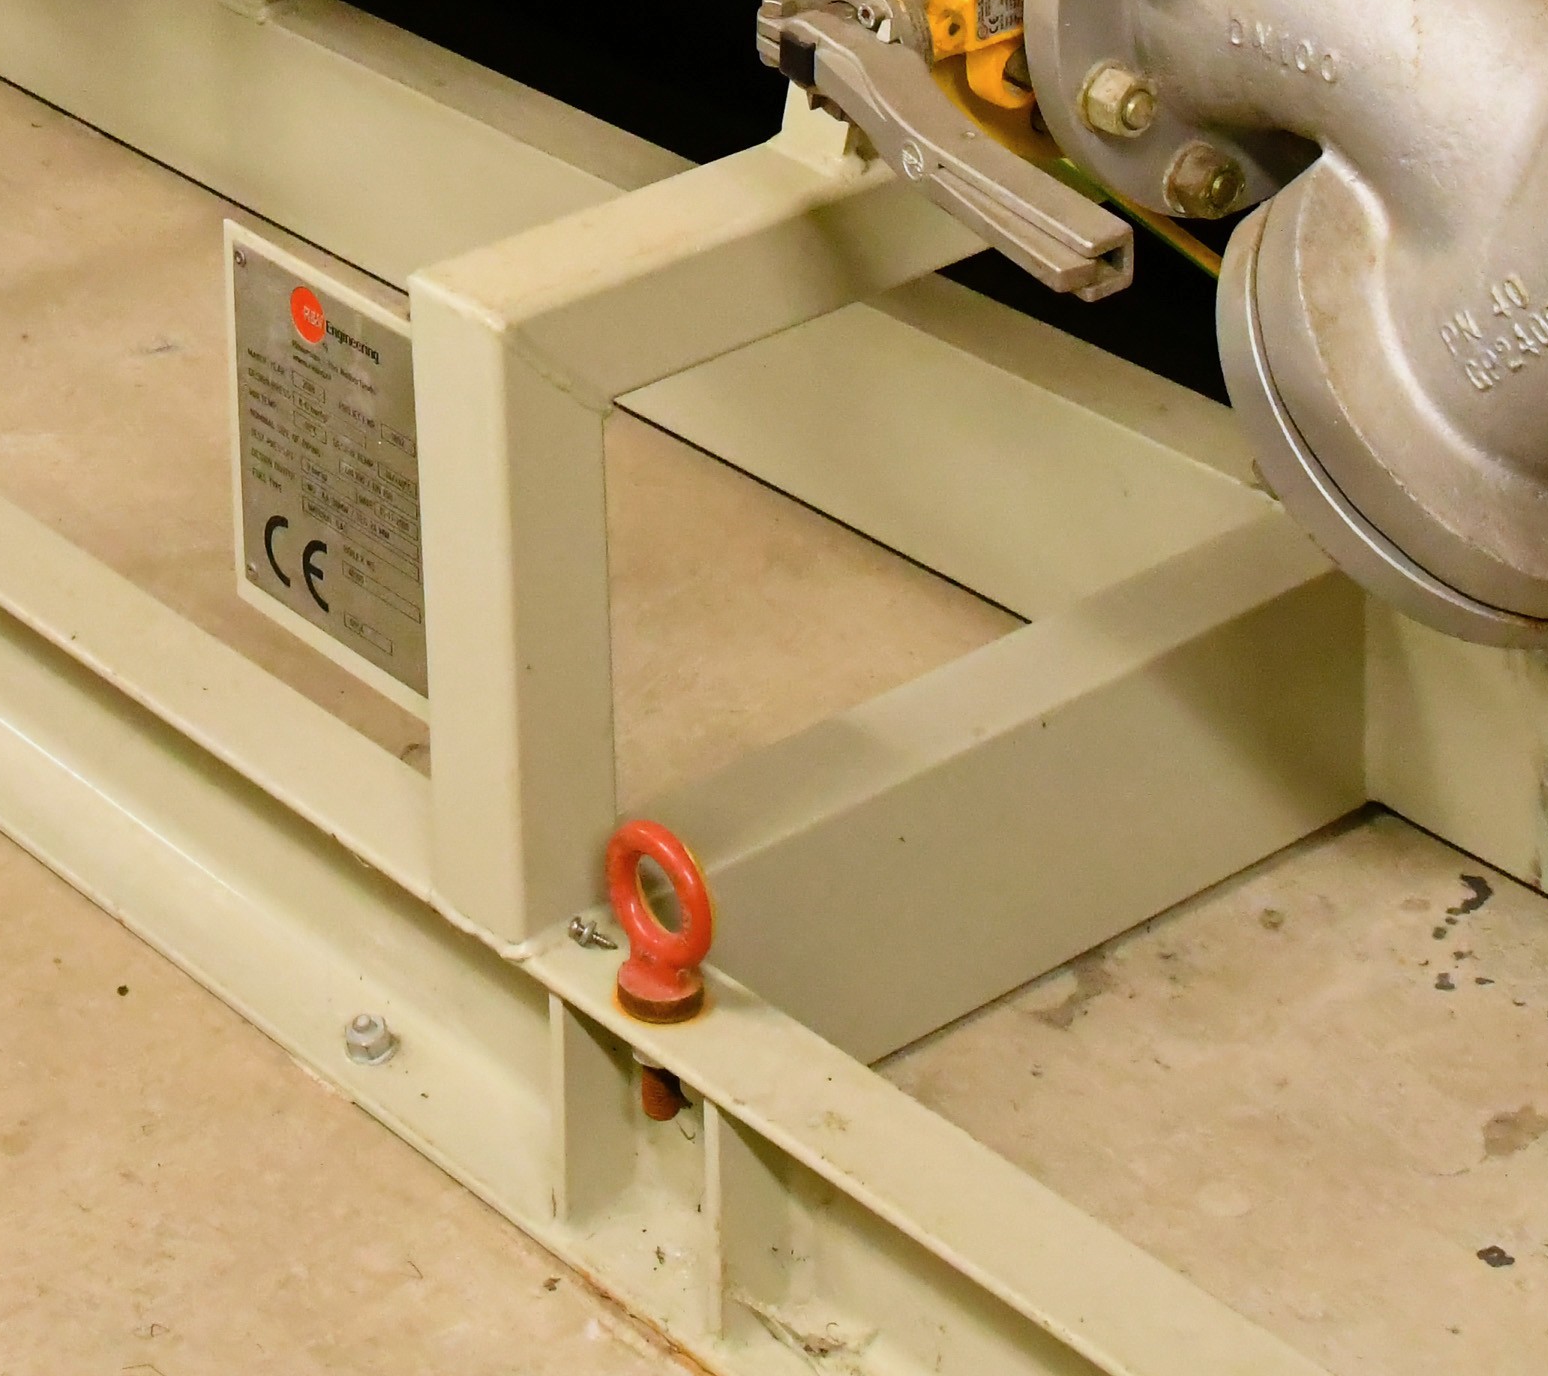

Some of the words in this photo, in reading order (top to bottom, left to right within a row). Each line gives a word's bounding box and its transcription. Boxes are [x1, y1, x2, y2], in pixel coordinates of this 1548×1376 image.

[325, 319, 380, 365] Engineering
[1441, 309, 1483, 357] PN
[1491, 273, 1531, 318] 40
[264, 514, 330, 613] CE
